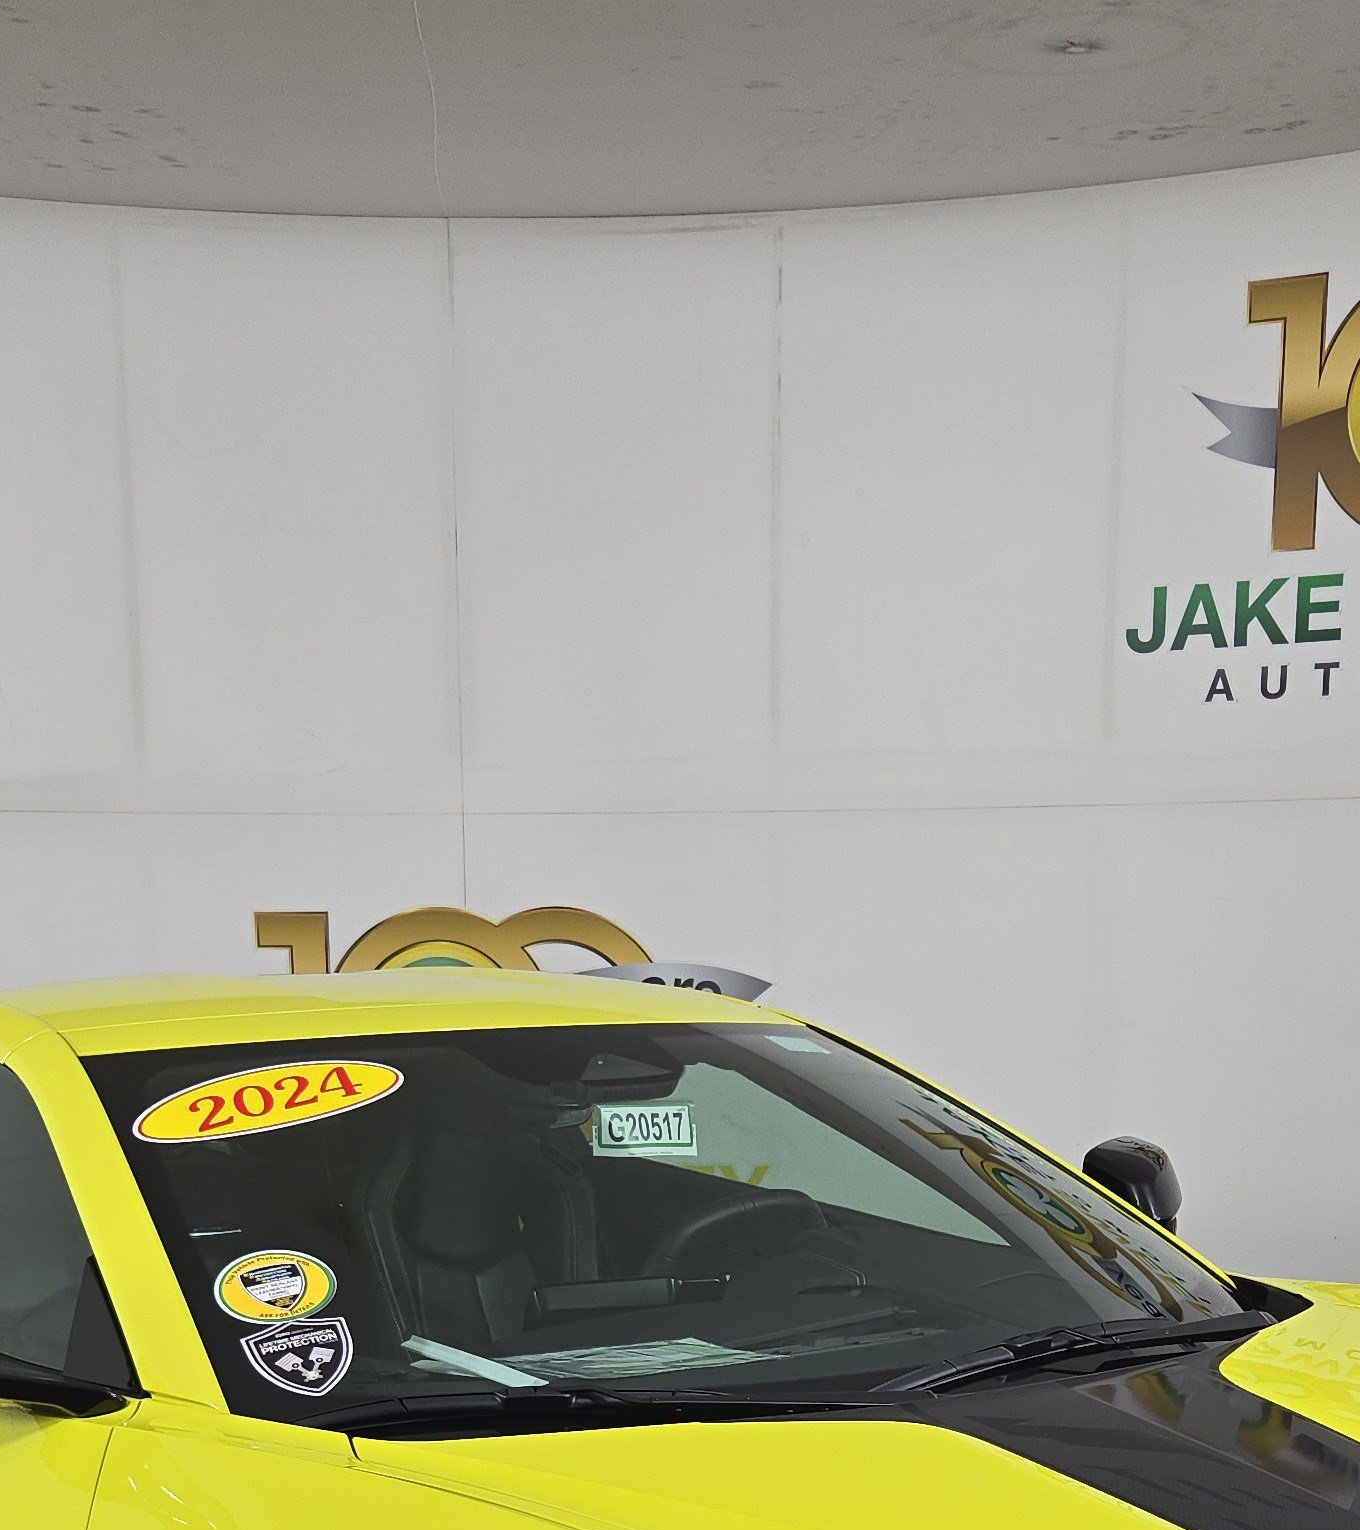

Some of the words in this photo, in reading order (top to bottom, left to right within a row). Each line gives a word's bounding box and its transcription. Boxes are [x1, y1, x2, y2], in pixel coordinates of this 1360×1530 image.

[1125, 572, 1345, 655] JAKE
[189, 1067, 363, 1133] 2024
[608, 1112, 683, 1143] G20517
[260, 1331, 339, 1356] PROTECTION
